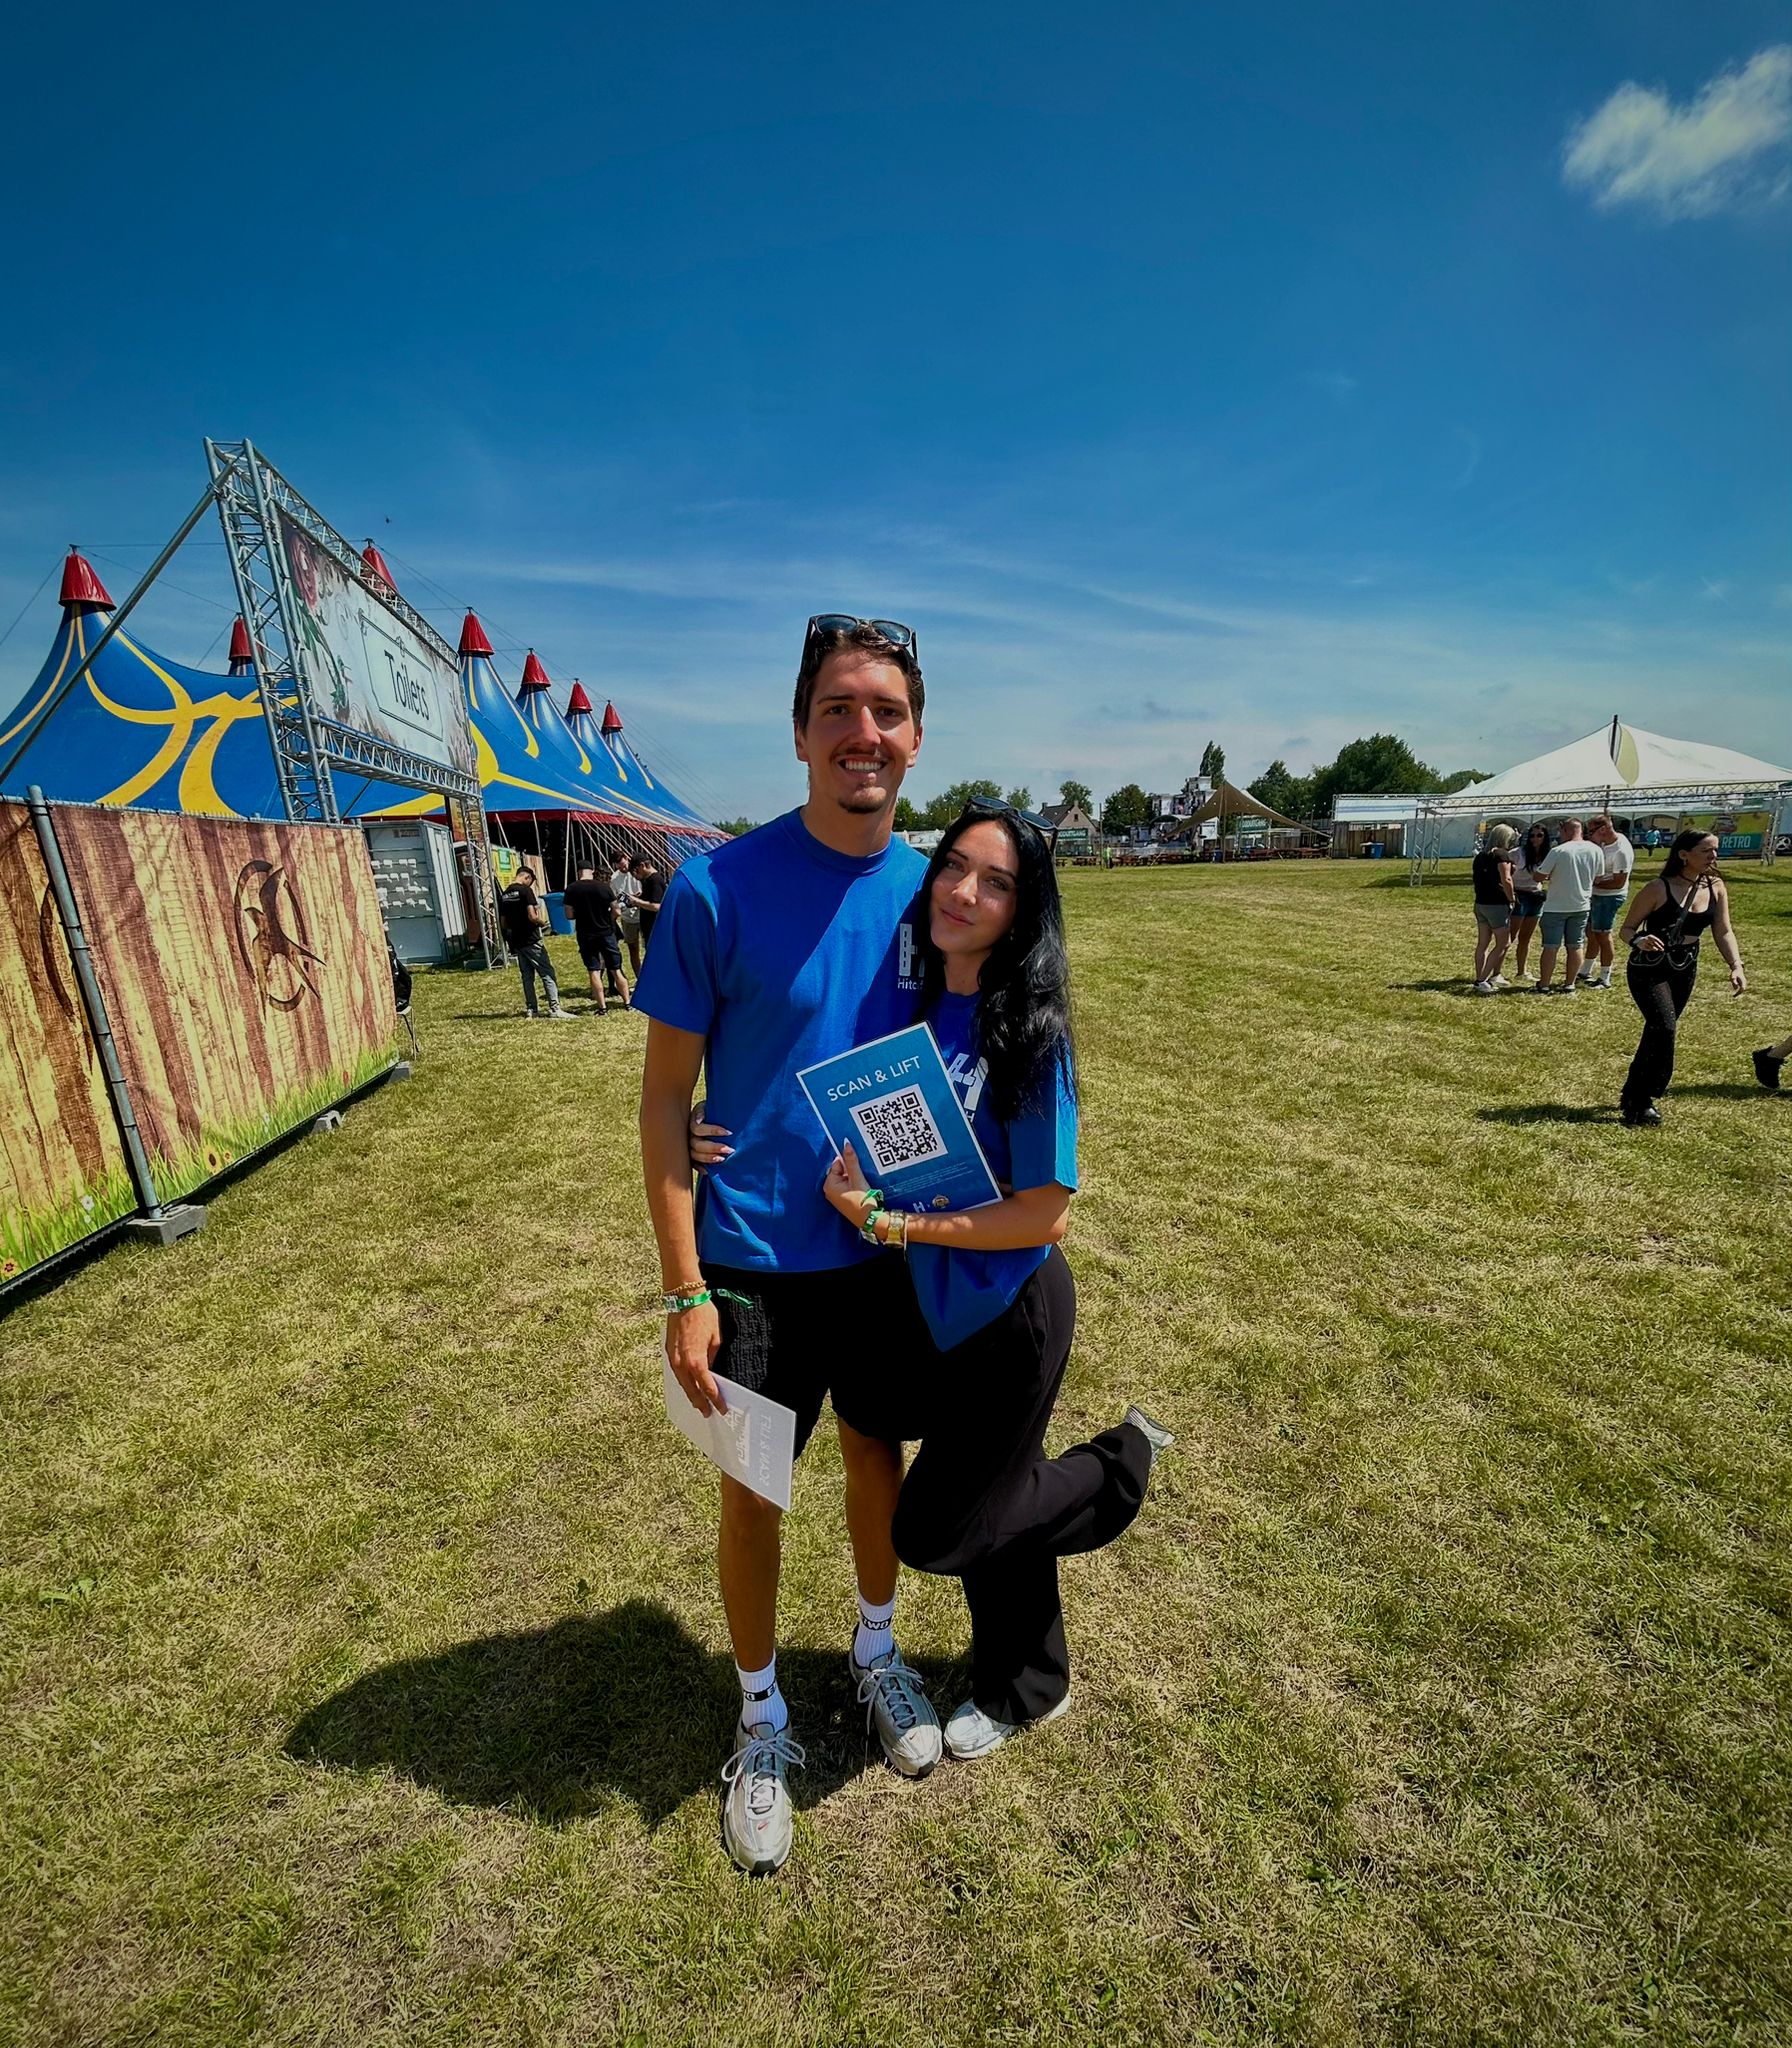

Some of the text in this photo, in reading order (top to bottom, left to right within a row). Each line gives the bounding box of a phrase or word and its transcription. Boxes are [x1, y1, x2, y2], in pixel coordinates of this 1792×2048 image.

[384, 649, 430, 720] Toilets
[1721, 835, 1751, 848] RETRO
[827, 1055, 920, 1102] SCAN & LIFT
